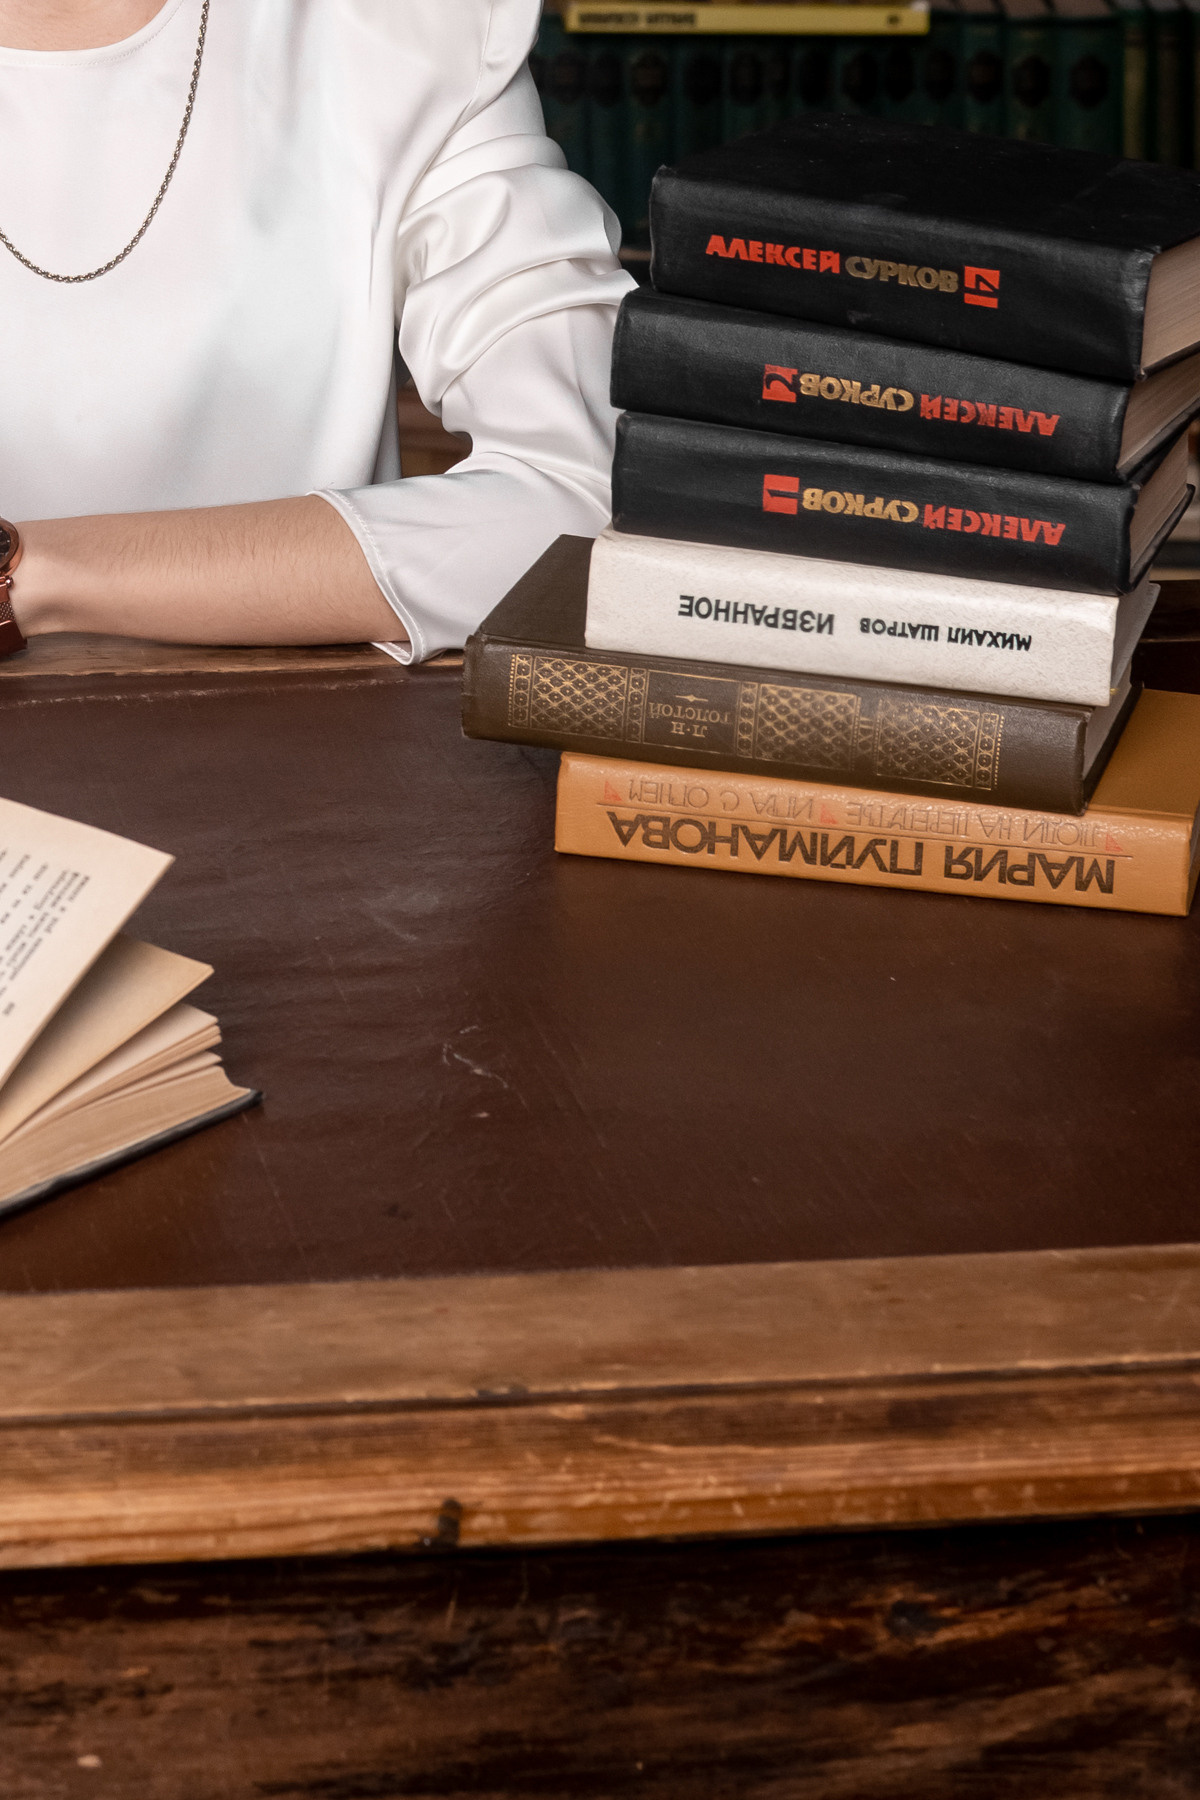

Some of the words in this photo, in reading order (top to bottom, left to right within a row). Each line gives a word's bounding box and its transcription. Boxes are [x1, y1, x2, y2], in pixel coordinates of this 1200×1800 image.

[705, 234, 840, 275] АЛЕКСЕЙ
[845, 255, 960, 293] СУРКОВ
[799, 372, 915, 412] СУРКОВ
[919, 393, 1061, 436] АЛЕКСЕЙ
[802, 487, 919, 524] СУРКОВ
[923, 503, 1066, 546] АЛЕКСЕЙ
[677, 594, 835, 636] ИЗБРАННОЕ
[859, 617, 939, 643] ШАТРОВ
[947, 626, 1032, 652] МИХАИЛ
[648, 702, 731, 727] ТОЛСТОЙ
[750, 792, 815, 821] ИГРА
[977, 812, 1013, 839] НА
[606, 811, 924, 876] ПУЙМАНОВА
[943, 845, 1115, 895] МАРИЯ
